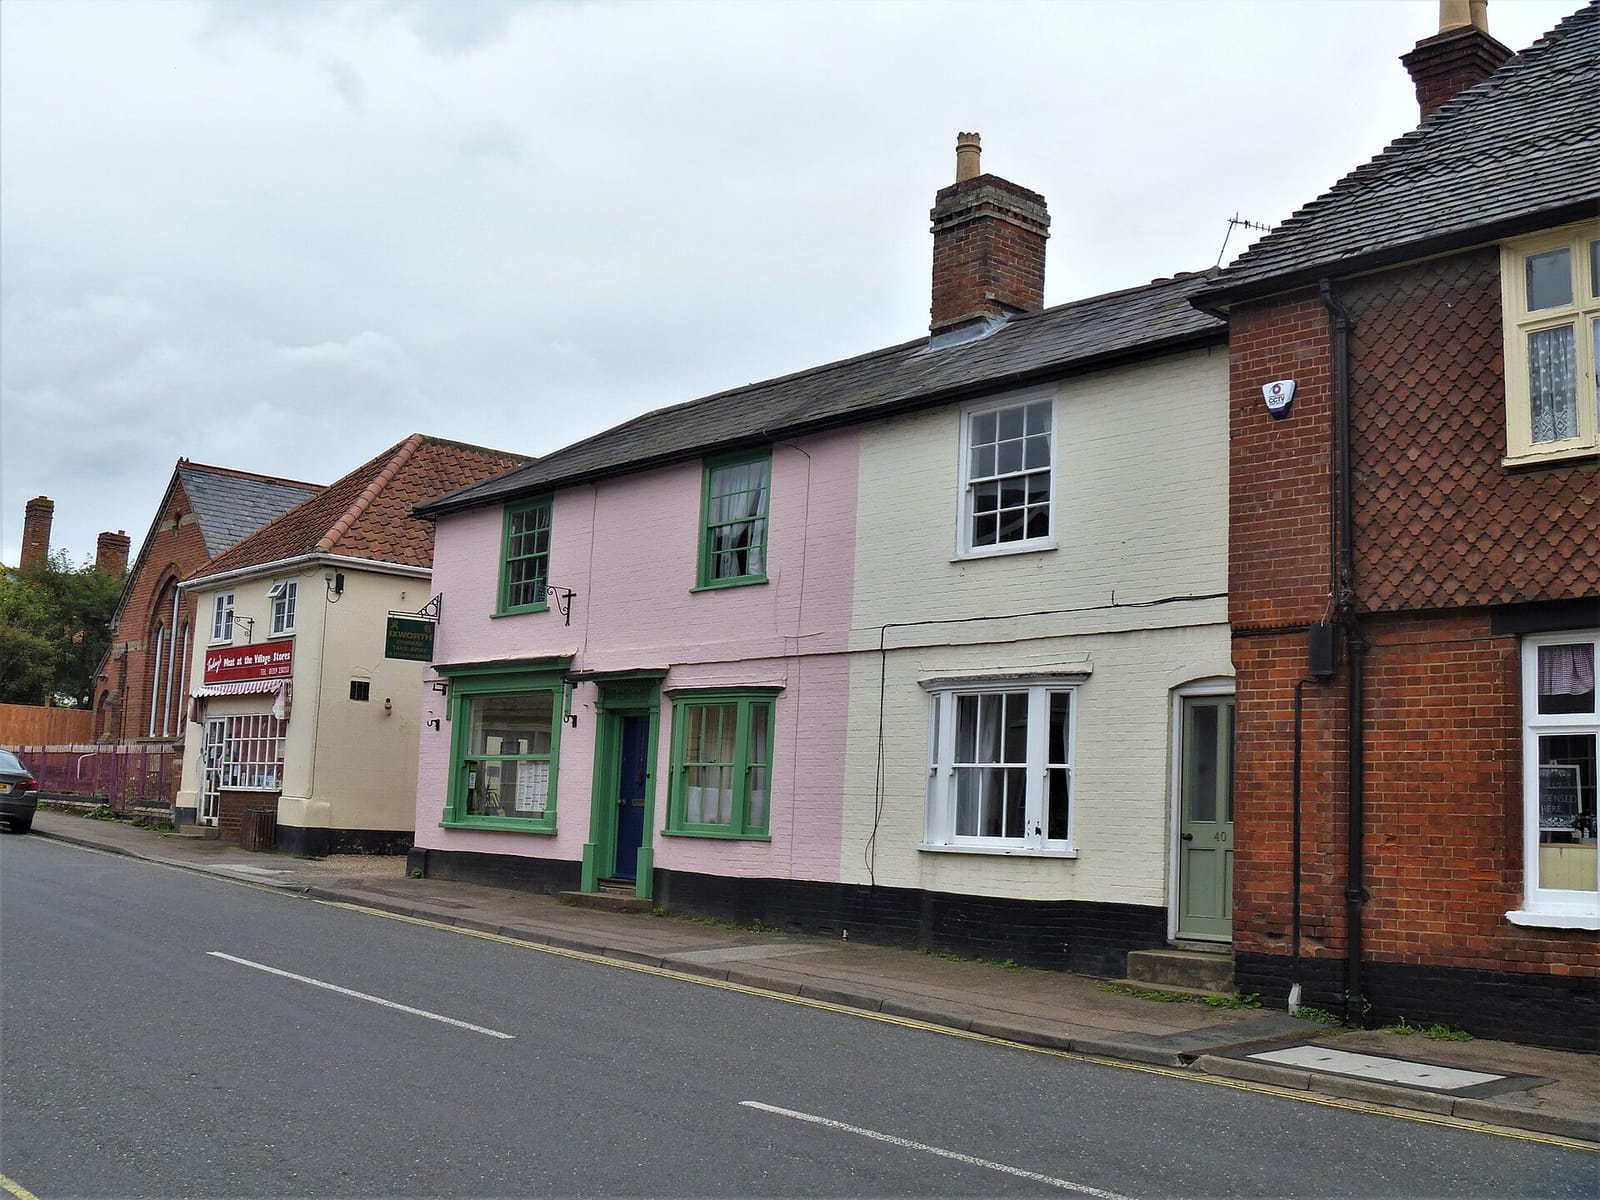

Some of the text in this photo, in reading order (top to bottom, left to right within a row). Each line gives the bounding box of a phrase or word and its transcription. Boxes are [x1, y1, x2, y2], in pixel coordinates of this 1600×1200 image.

[1269, 396, 1285, 404] CCTV
[389, 630, 433, 640] IXWORTH
[244, 655, 253, 665] the
[254, 654, 271, 666] Village
[273, 652, 291, 662] Stores
[1214, 831, 1227, 842] 40
